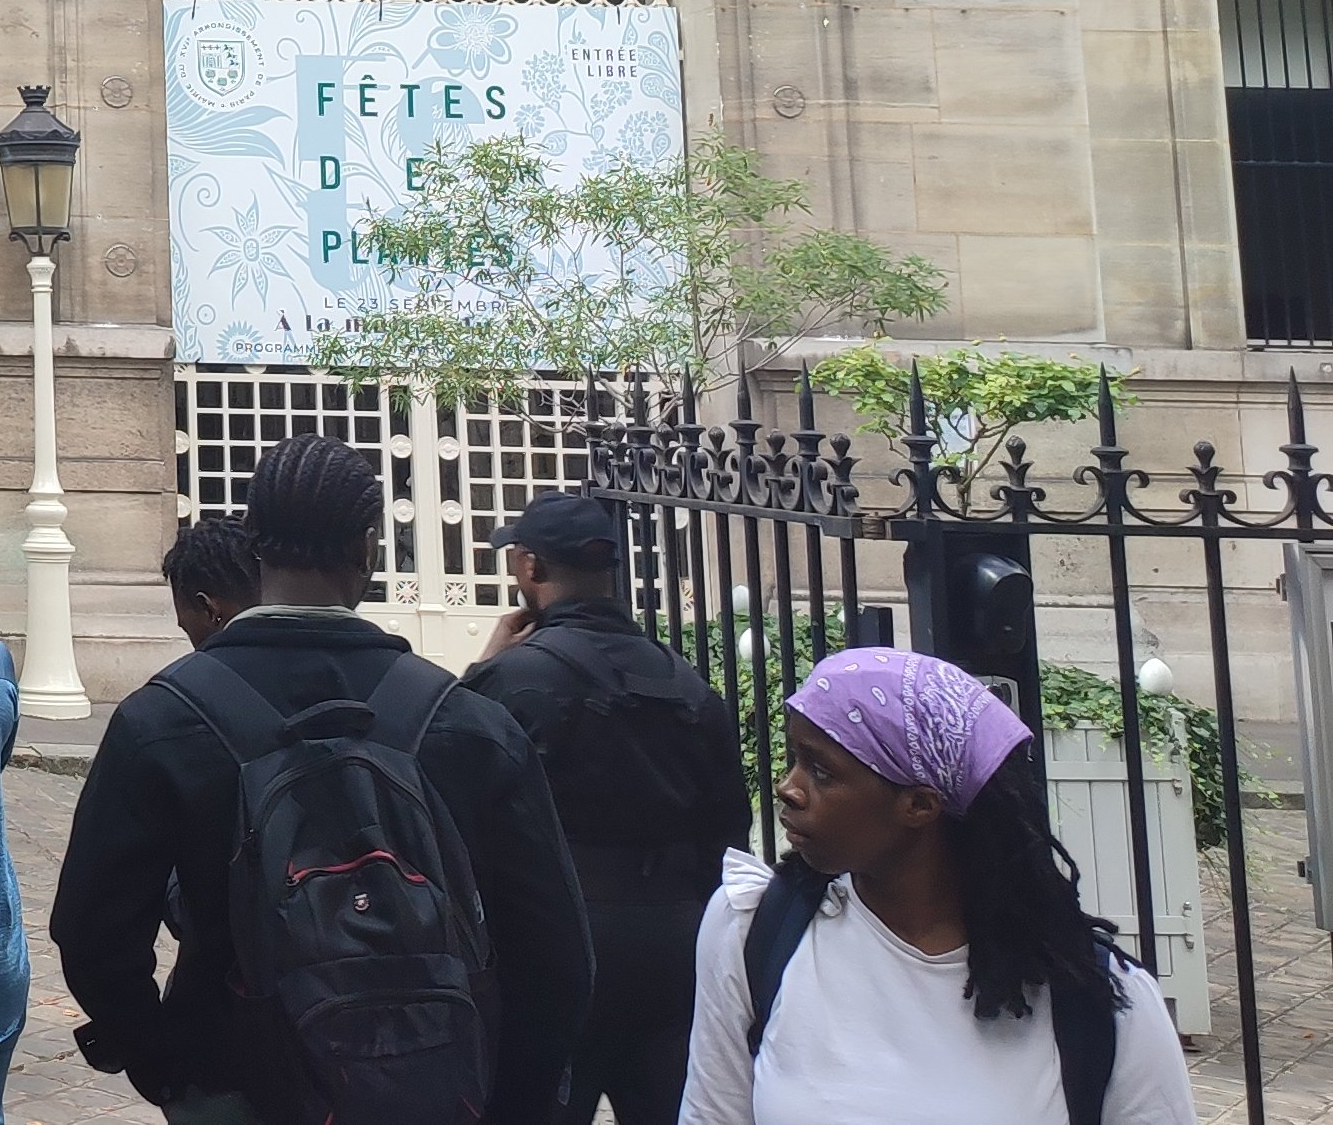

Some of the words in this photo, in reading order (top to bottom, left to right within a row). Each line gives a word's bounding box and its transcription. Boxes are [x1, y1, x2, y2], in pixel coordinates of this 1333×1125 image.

[179, 64, 187, 78] DU
[193, 22, 265, 66] ARRONDISSEMENT
[255, 73, 264, 86] DE
[571, 46, 637, 62] ENTRÉE
[588, 65, 638, 78] LIBRE
[317, 74, 507, 120] FÊTES
[325, 297, 346, 309] LE
[357, 297, 379, 310] 23
[305, 315, 332, 332] la
